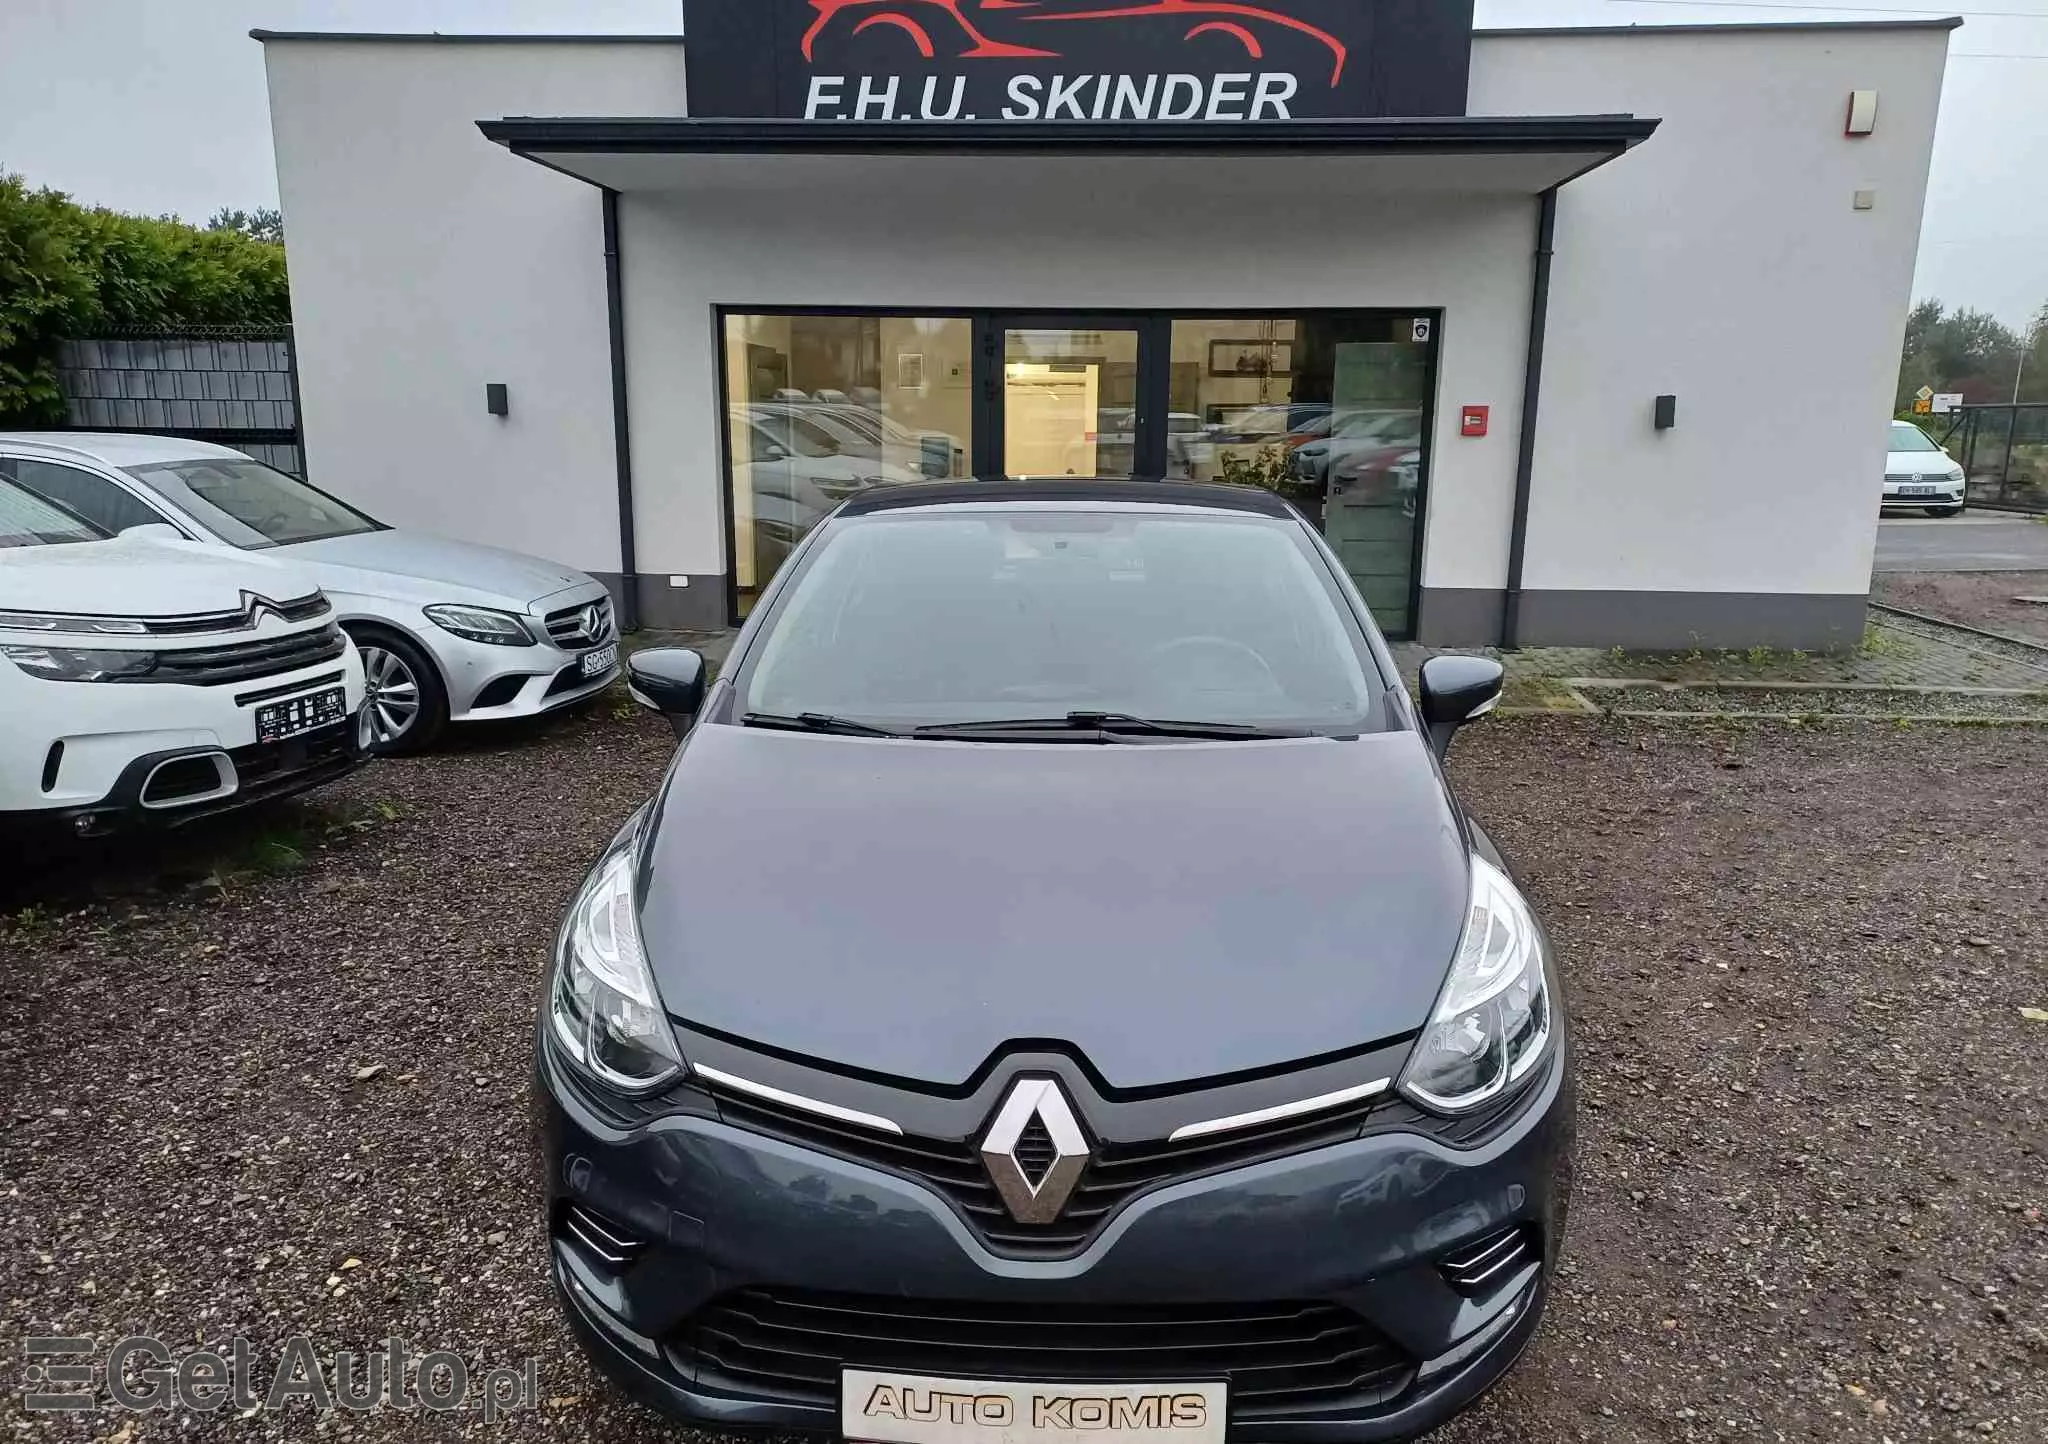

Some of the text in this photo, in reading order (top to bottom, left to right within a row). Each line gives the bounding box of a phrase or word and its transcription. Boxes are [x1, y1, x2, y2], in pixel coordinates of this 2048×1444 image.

[804, 73, 1298, 120] F.H.U. SKINDER
[864, 1384, 1207, 1430] AUTO KOMIS
